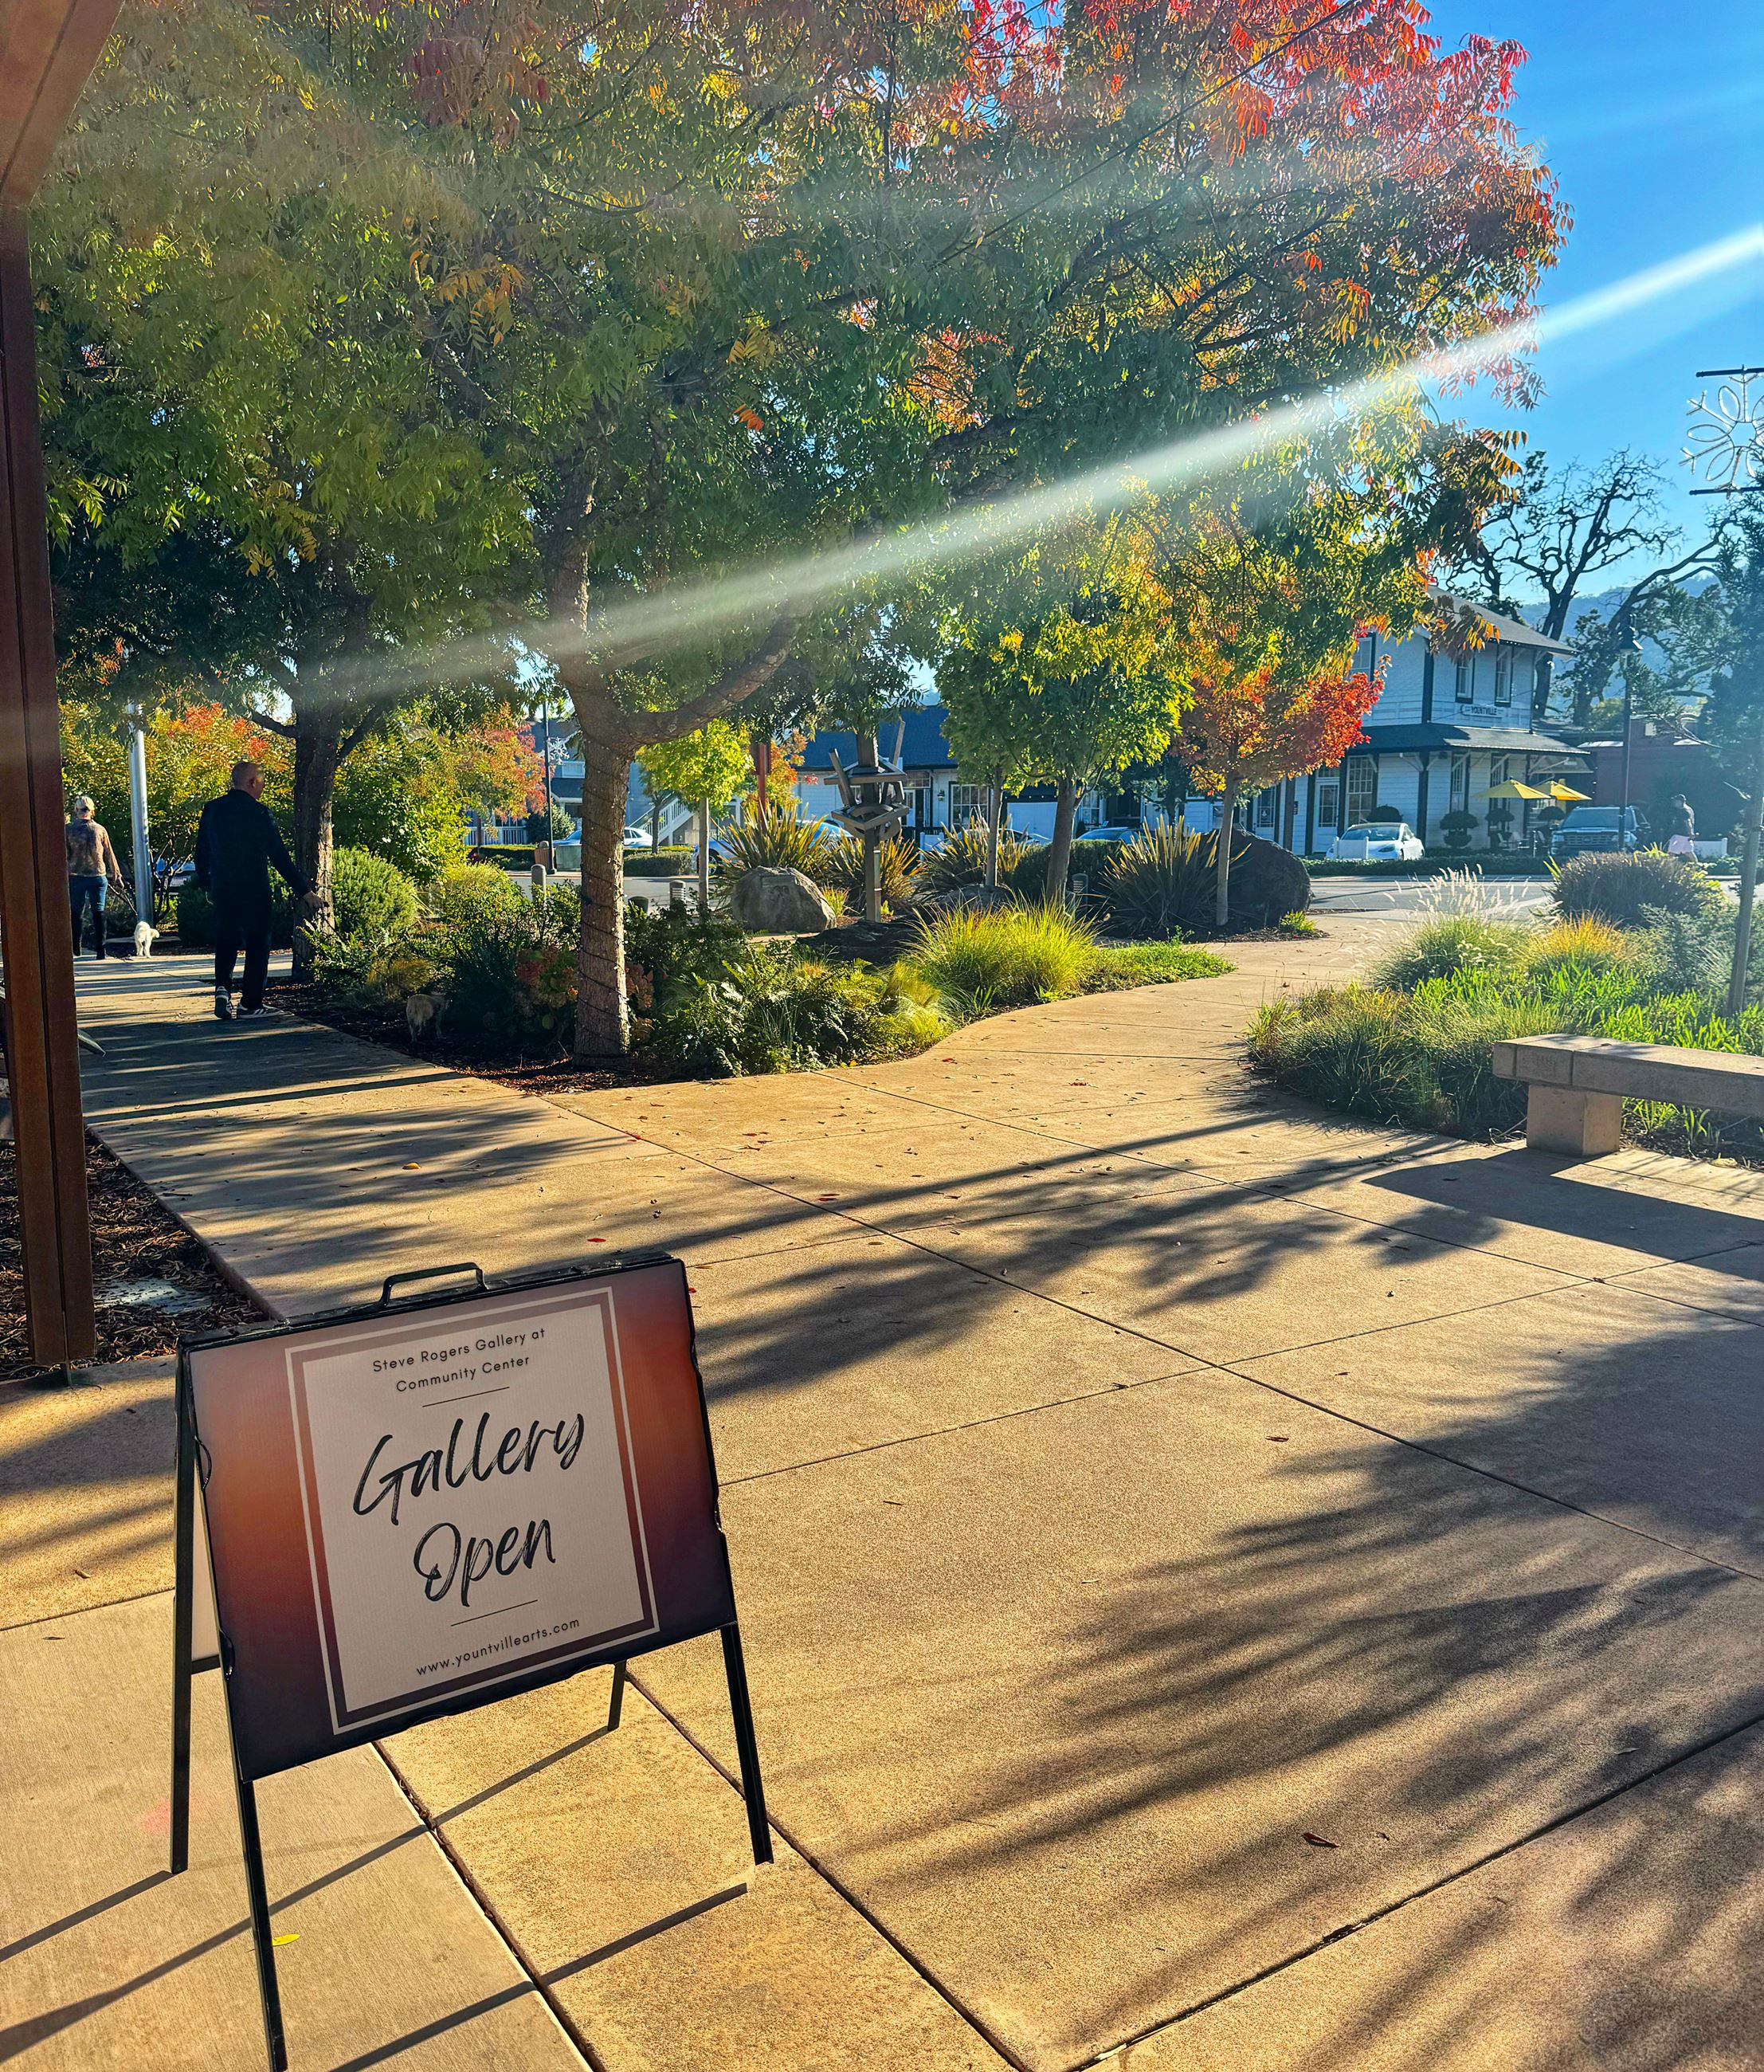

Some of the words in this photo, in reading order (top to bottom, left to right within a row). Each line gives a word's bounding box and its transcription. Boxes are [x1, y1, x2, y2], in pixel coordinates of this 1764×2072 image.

[372, 1356, 415, 1372] Steve
[421, 1344, 471, 1362] Rogers
[475, 1333, 527, 1352] Gallery
[531, 1328, 546, 1340] at
[395, 1367, 477, 1393] Community
[481, 1356, 531, 1374] Center
[352, 1411, 585, 1526] Gallery
[413, 1518, 556, 1607] Open
[415, 1618, 580, 1676] www.yountvillearts.com
